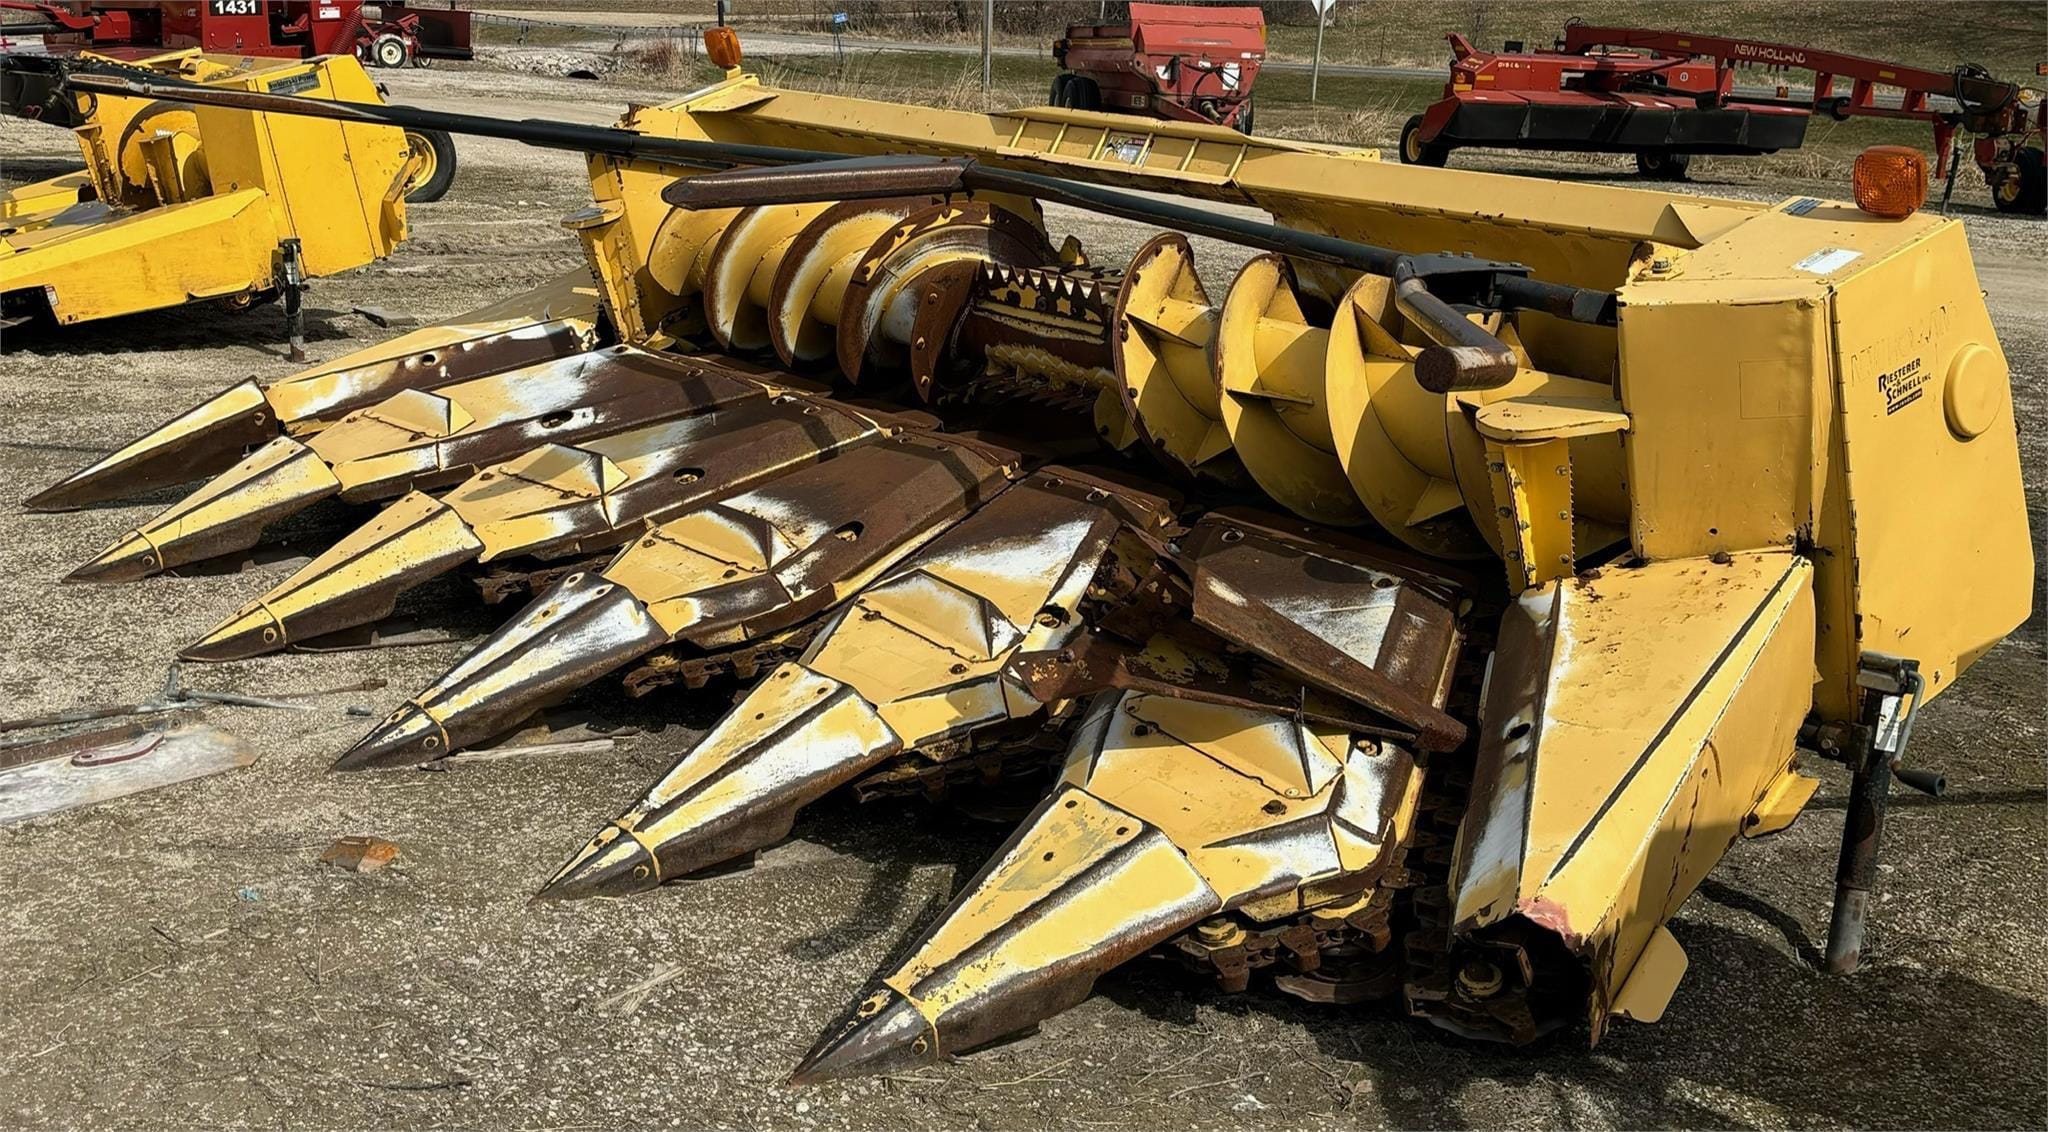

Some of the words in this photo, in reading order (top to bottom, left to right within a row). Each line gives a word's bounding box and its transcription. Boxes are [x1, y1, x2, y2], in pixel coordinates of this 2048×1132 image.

[215, 0, 256, 14] 1431
[1734, 44, 1757, 57] NEW
[1878, 358, 1921, 392] RIESTERER
[1886, 376, 1921, 405] SCHNELL
